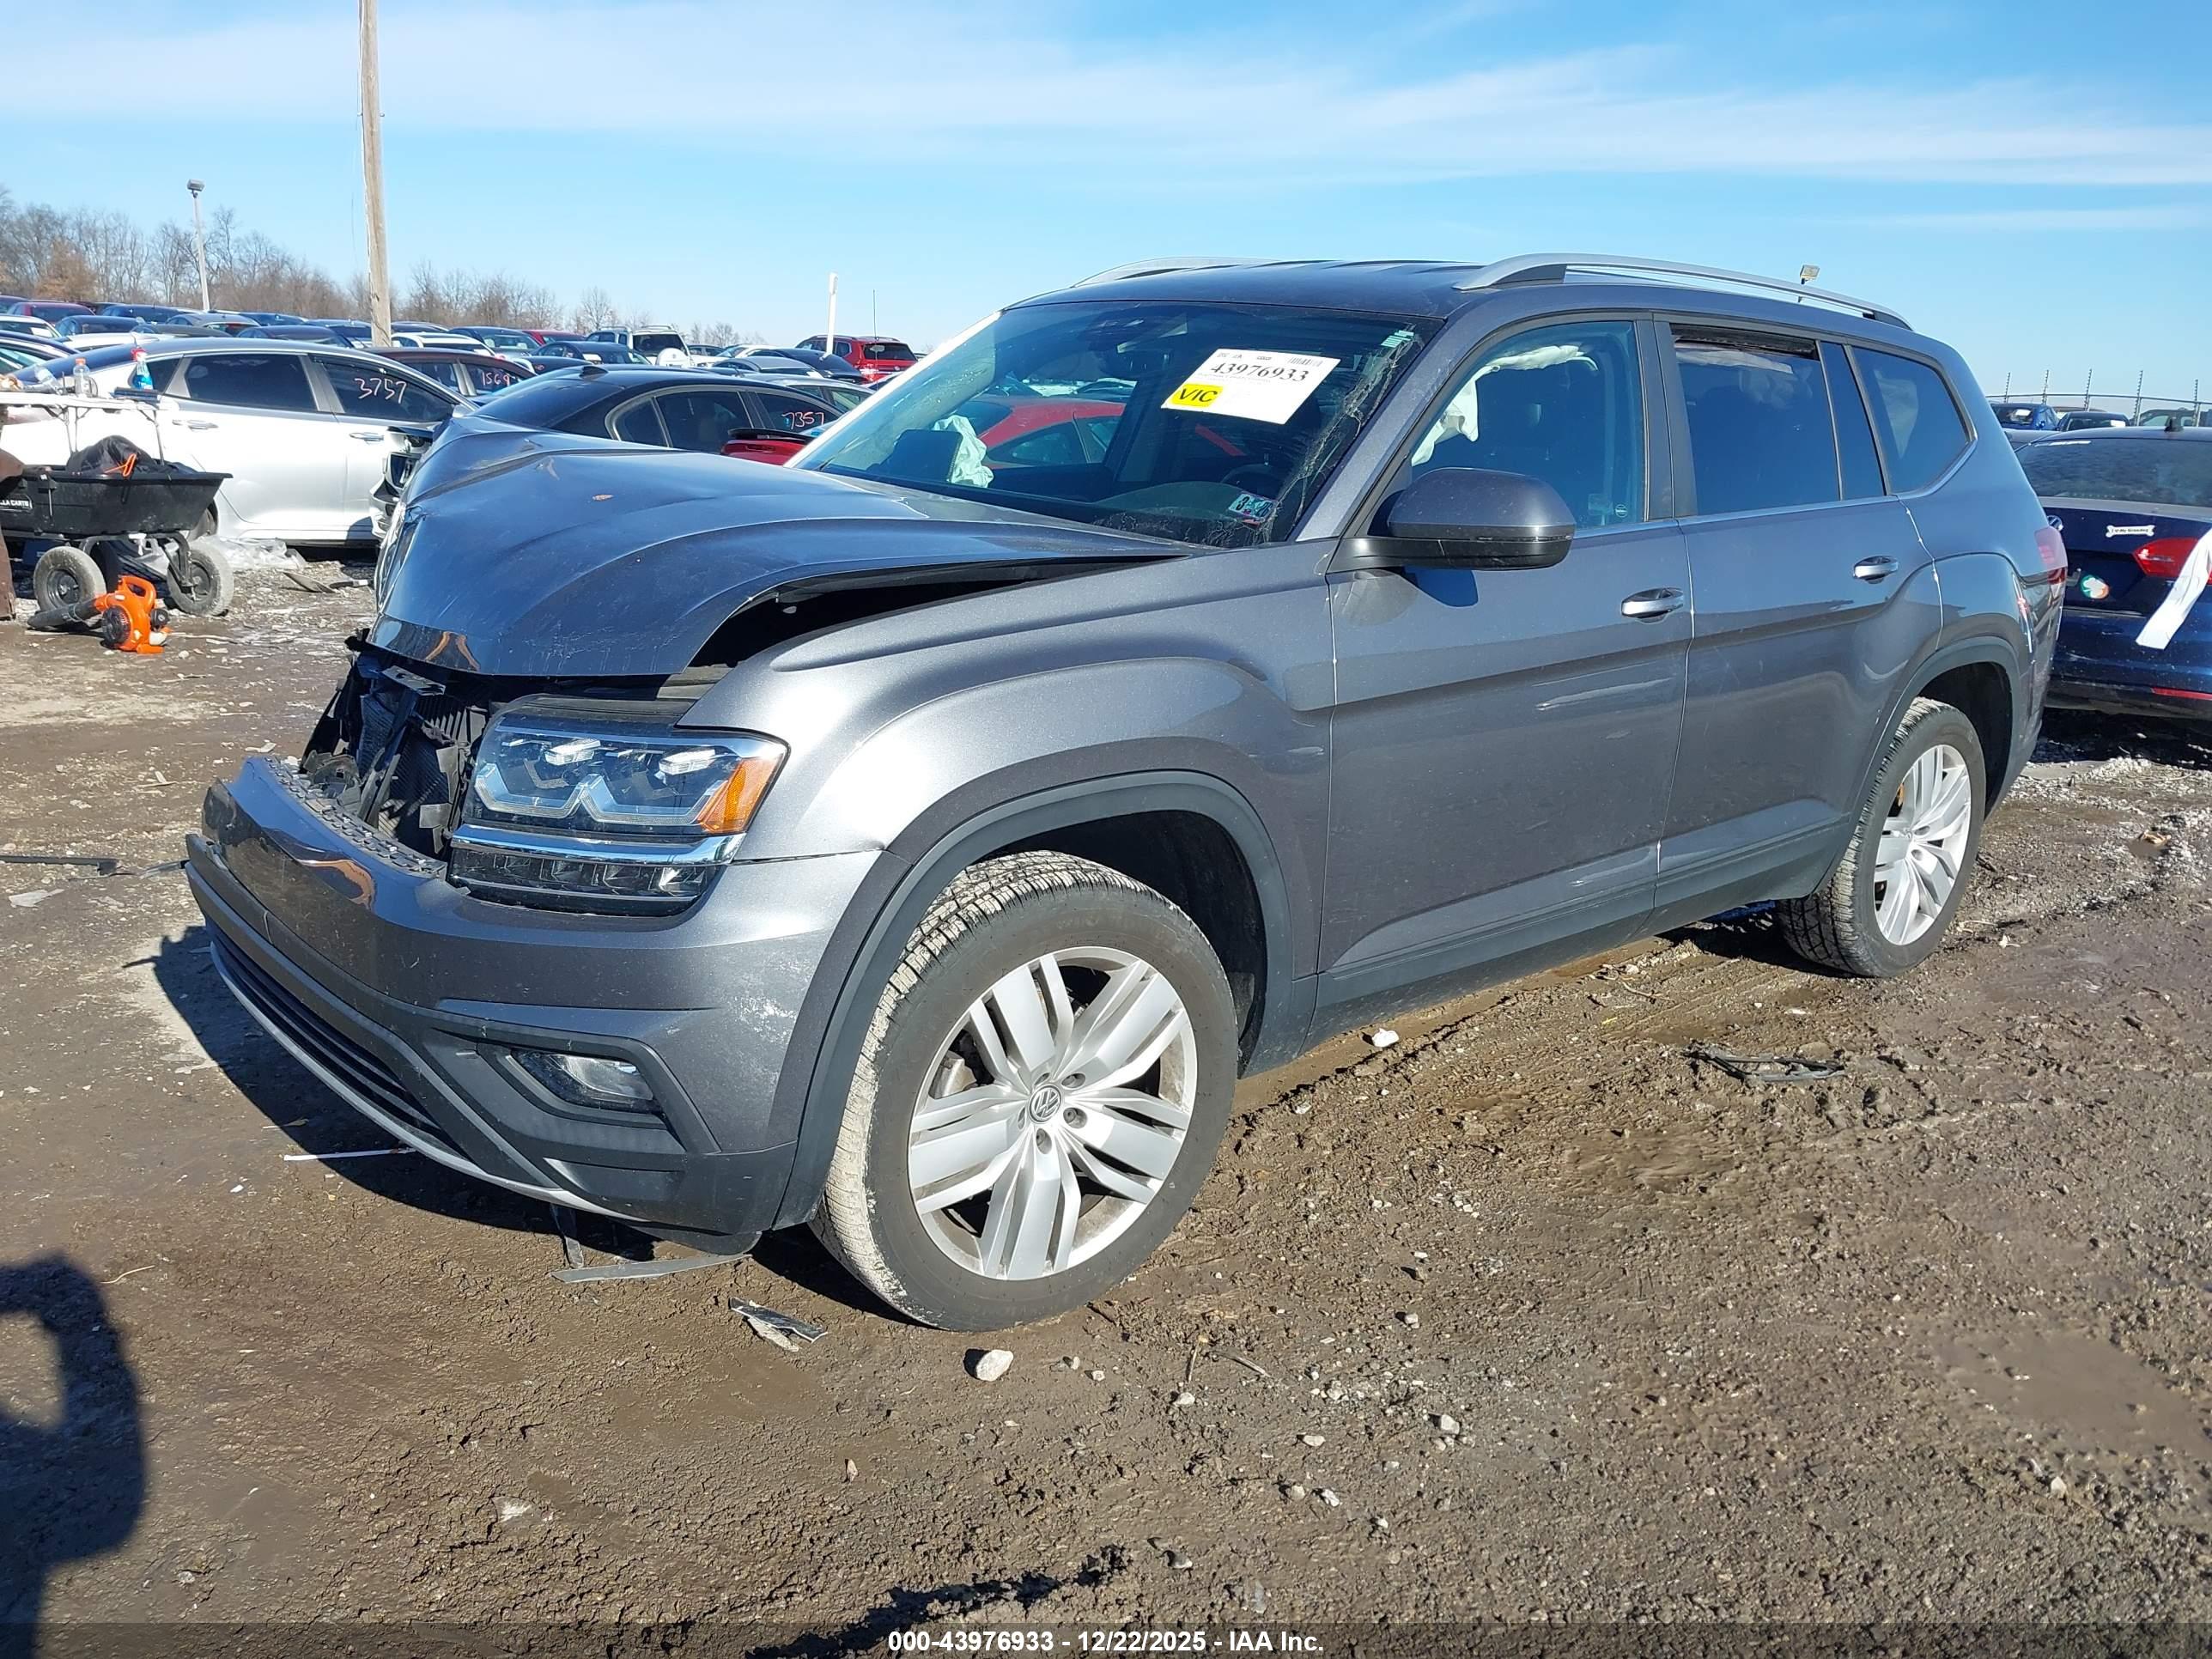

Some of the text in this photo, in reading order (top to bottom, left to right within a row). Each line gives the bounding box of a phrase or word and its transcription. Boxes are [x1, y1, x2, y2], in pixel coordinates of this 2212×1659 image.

[1211, 362, 1310, 382] 43976933
[355, 378, 407, 404] 3757
[1179, 388, 1218, 402] VIC
[781, 411, 824, 429] 7357
[1236, 495, 1250, 511] 3
